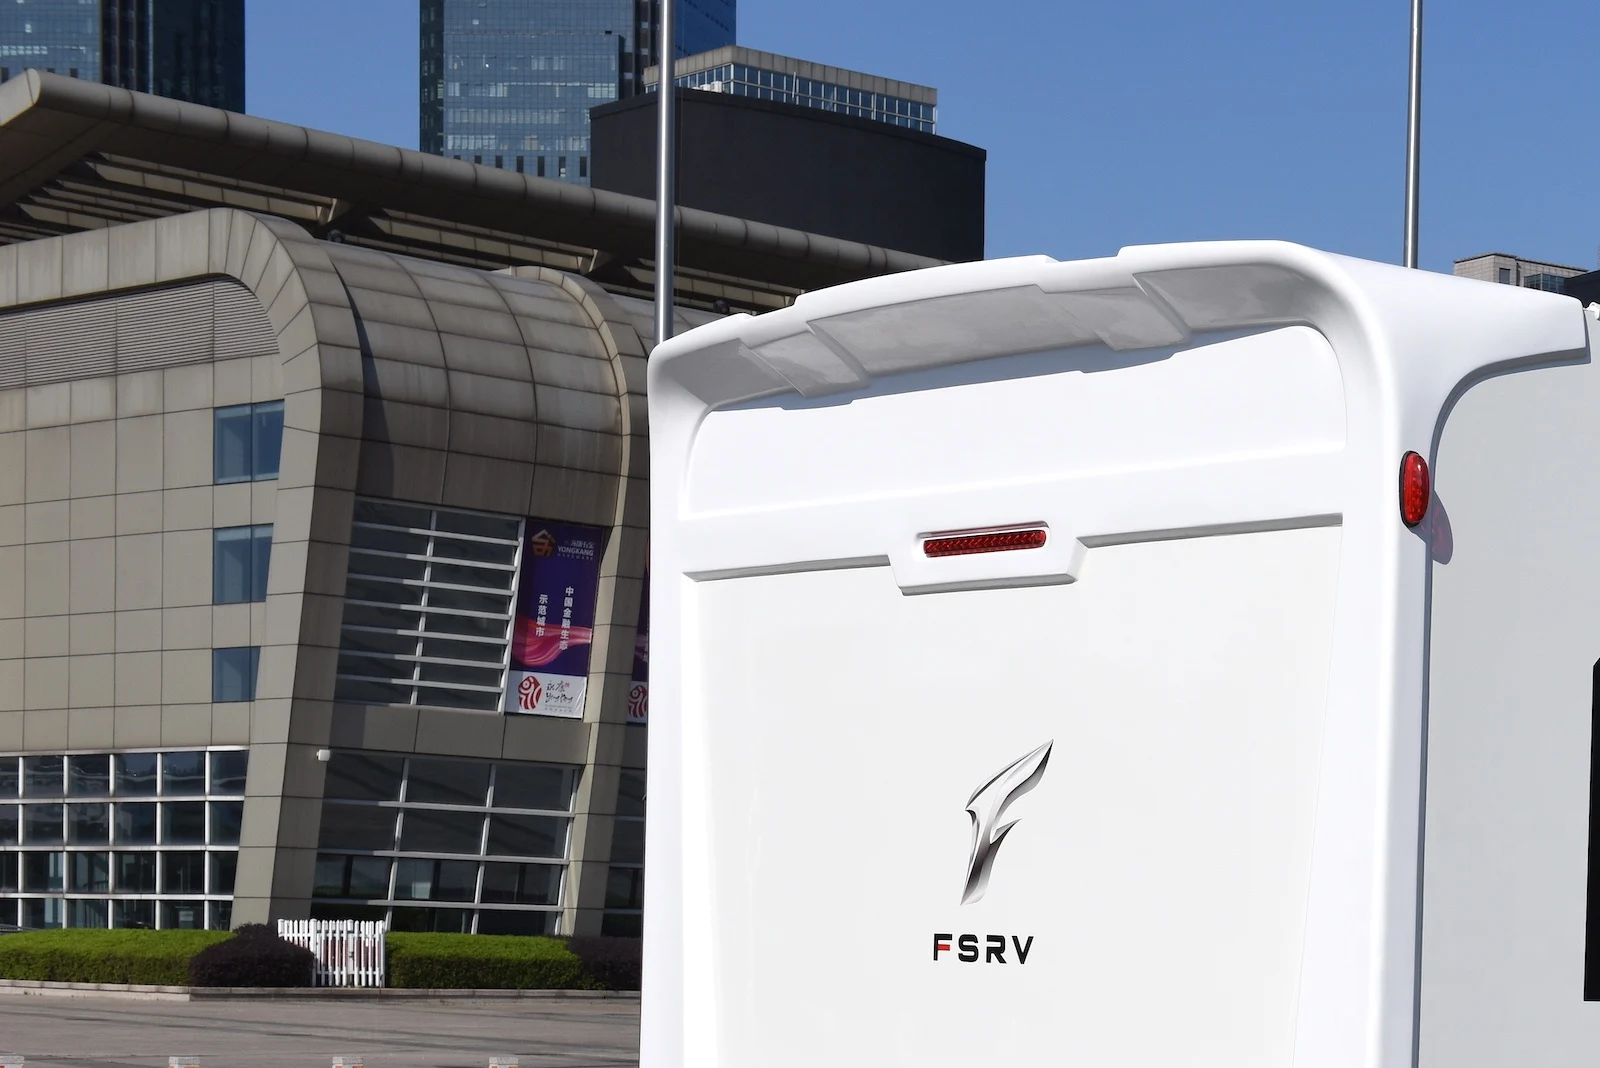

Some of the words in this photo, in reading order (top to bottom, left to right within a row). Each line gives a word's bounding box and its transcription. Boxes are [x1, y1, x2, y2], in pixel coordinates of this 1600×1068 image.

[557, 545, 594, 556] YONGKANG
[536, 594, 548, 637] 示范城市
[560, 586, 574, 651] 中国金融生态
[933, 933, 1034, 965] FSRV
